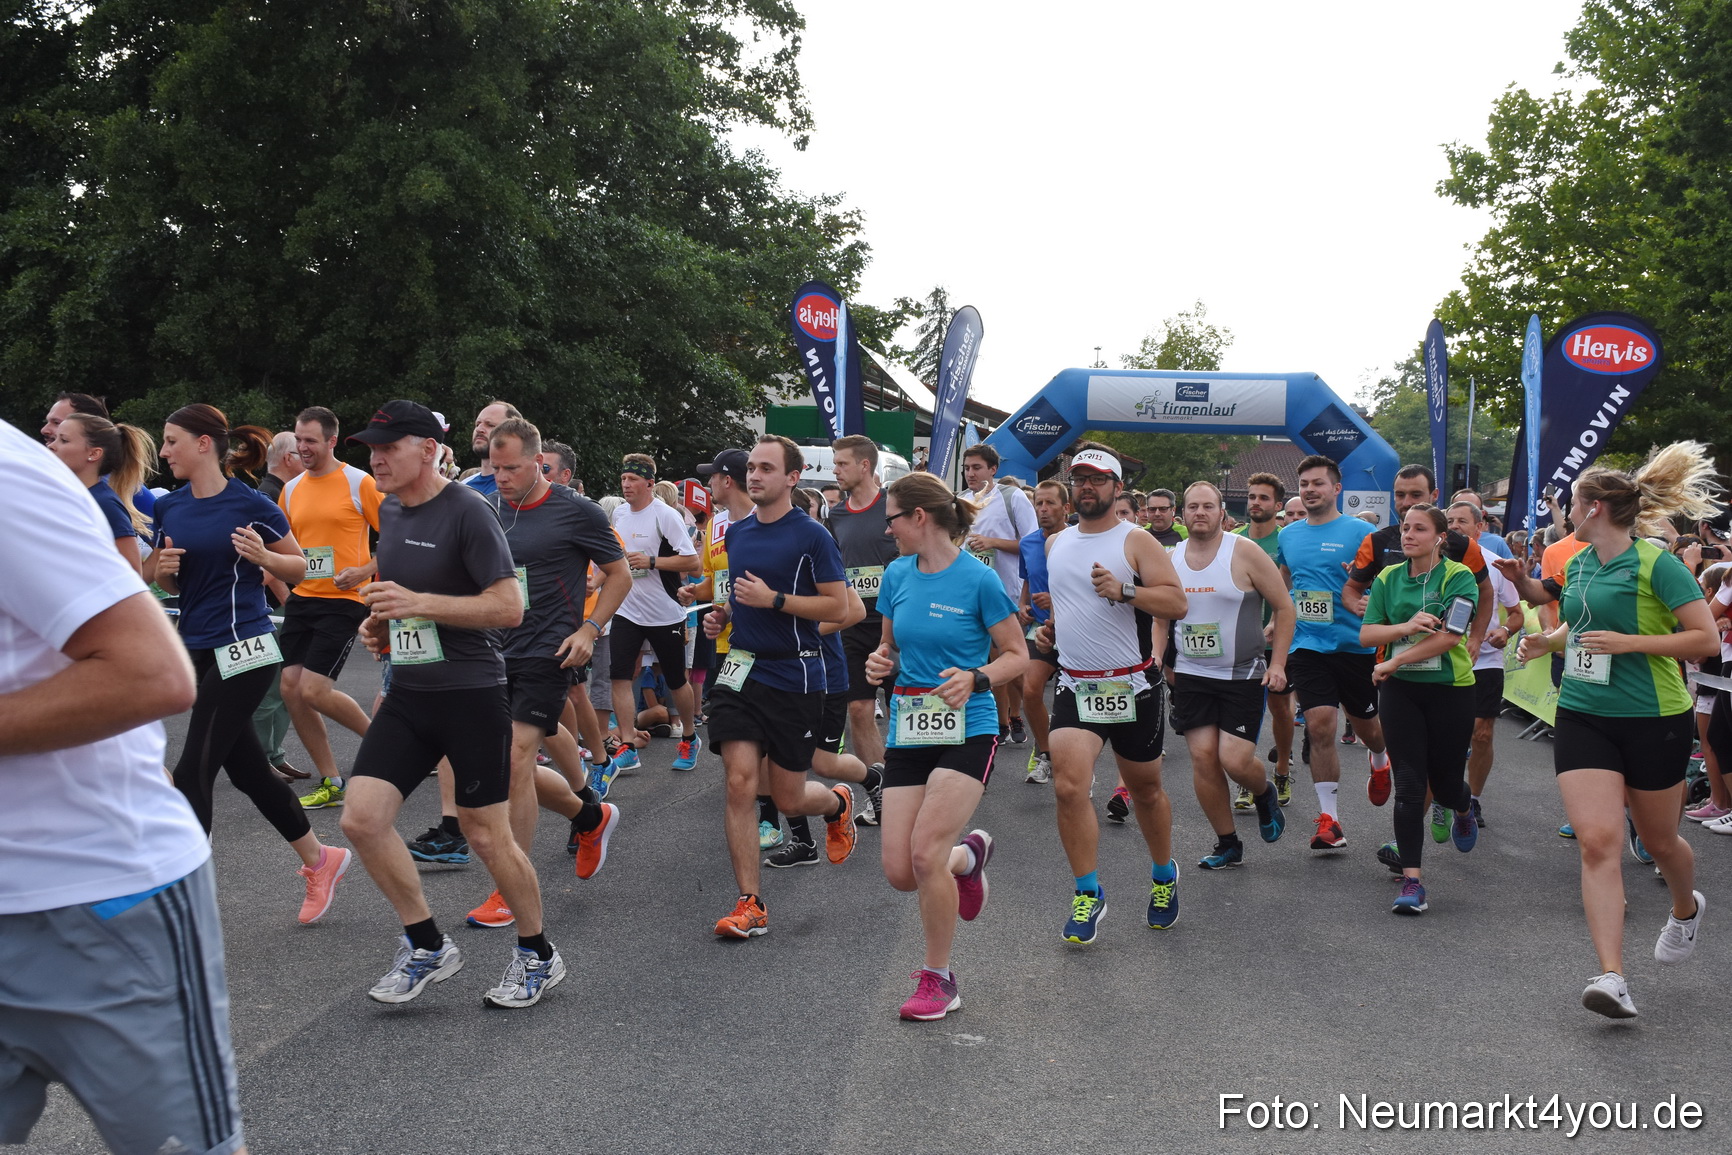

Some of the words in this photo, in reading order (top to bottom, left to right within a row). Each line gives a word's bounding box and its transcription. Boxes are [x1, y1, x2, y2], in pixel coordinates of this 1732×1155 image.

[1572, 334, 1647, 364] Hervis
[1163, 401, 1237, 417] firmenlauf
[1023, 421, 1063, 431] Fischer
[851, 577, 879, 589] 1490
[1299, 601, 1328, 614] 1858
[396, 631, 422, 650] 171
[1185, 635, 1216, 649] 1175
[228, 637, 266, 661] 814
[1576, 650, 1593, 669] 13
[1083, 695, 1128, 712] 1855
[530, 710, 548, 718] adidas
[905, 712, 956, 731] 1856
